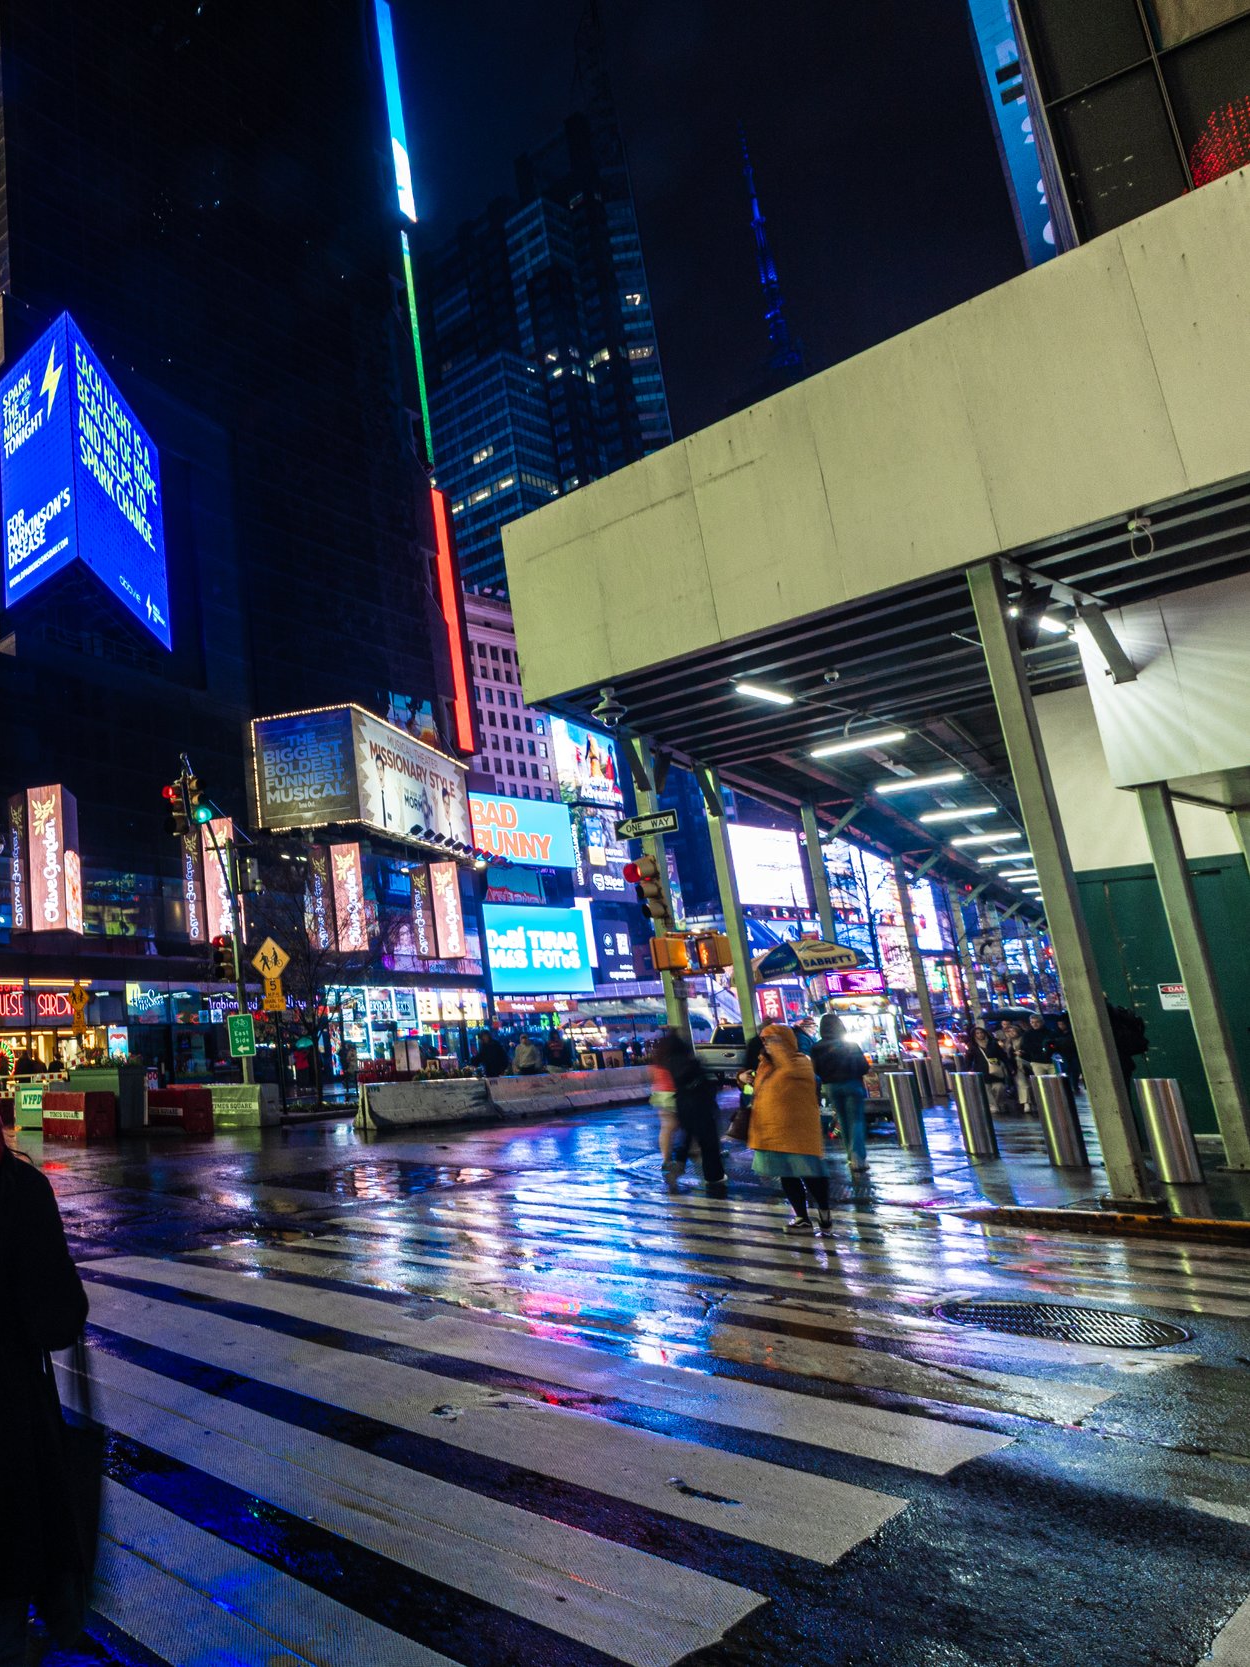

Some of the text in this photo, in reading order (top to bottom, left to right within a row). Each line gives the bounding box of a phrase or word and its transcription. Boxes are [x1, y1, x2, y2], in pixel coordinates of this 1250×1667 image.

[2, 369, 31, 412] SPARK
[3, 398, 21, 427] THE
[75, 342, 151, 472] EACH LIGHT IS A
[3, 404, 31, 443] NIGHT
[4, 408, 44, 459] TONIGHT
[76, 373, 158, 506] BEACON OF HOPE
[78, 405, 147, 514] AND HELPS TO
[80, 435, 116, 502] SPARK
[7, 508, 25, 537] FOR
[8, 487, 71, 554] PARKINSON'S
[8, 525, 46, 570] DISEASE
[265, 768, 345, 791] FUNNIEST
[369, 740, 456, 799] MISSIONARY STYLE
[471, 800, 518, 829] BAD
[626, 817, 670, 833] ONE WAY
[473, 828, 552, 860] BUNNY
[42, 817, 62, 922] Olive Garden
[803, 955, 852, 968] SABRETT
[269, 980, 277, 991] 5
[209, 997, 239, 1010] Arabian
[763, 989, 779, 1019] tkts
[22, 1093, 42, 1105] NYPD
[230, 1102, 253, 1110] SQUARE
